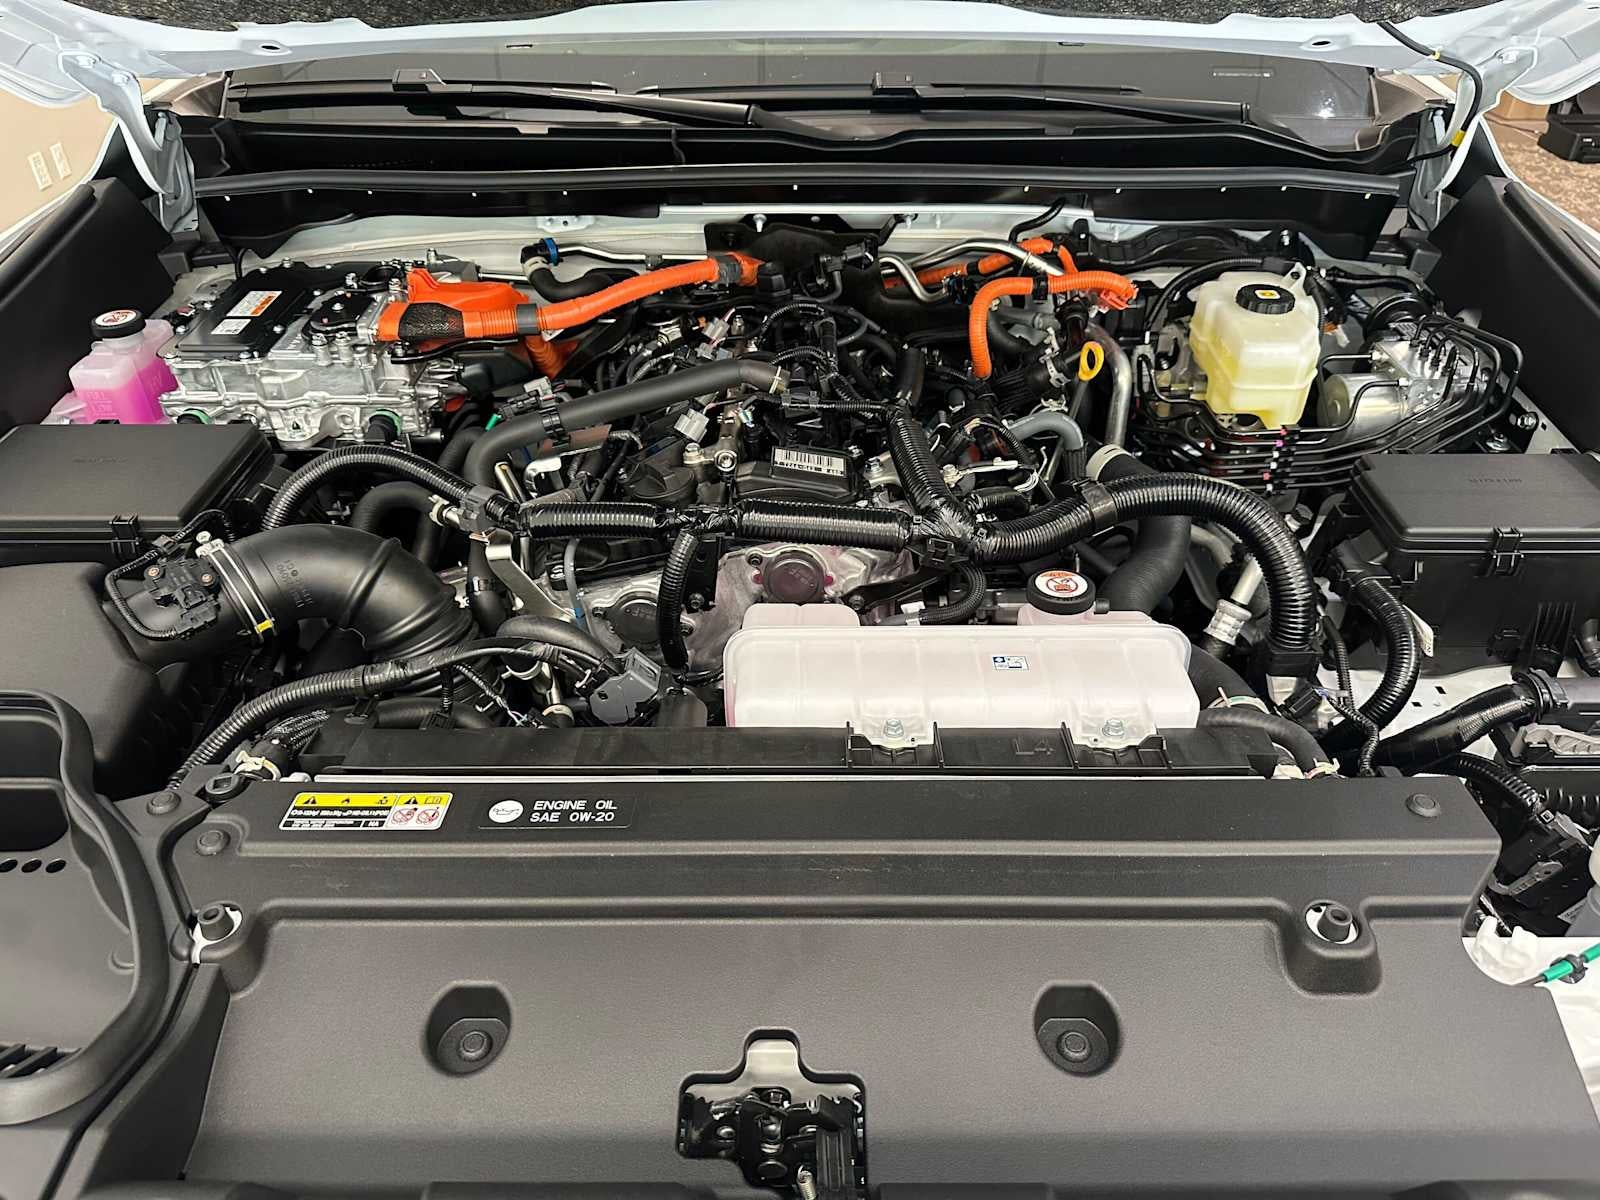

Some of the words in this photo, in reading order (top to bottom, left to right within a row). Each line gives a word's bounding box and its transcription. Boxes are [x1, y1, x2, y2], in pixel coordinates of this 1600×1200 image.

[533, 799, 587, 810] ENGINE
[595, 799, 617, 810] OIL
[529, 811, 561, 822] SAE
[569, 811, 614, 822] 0W-20
